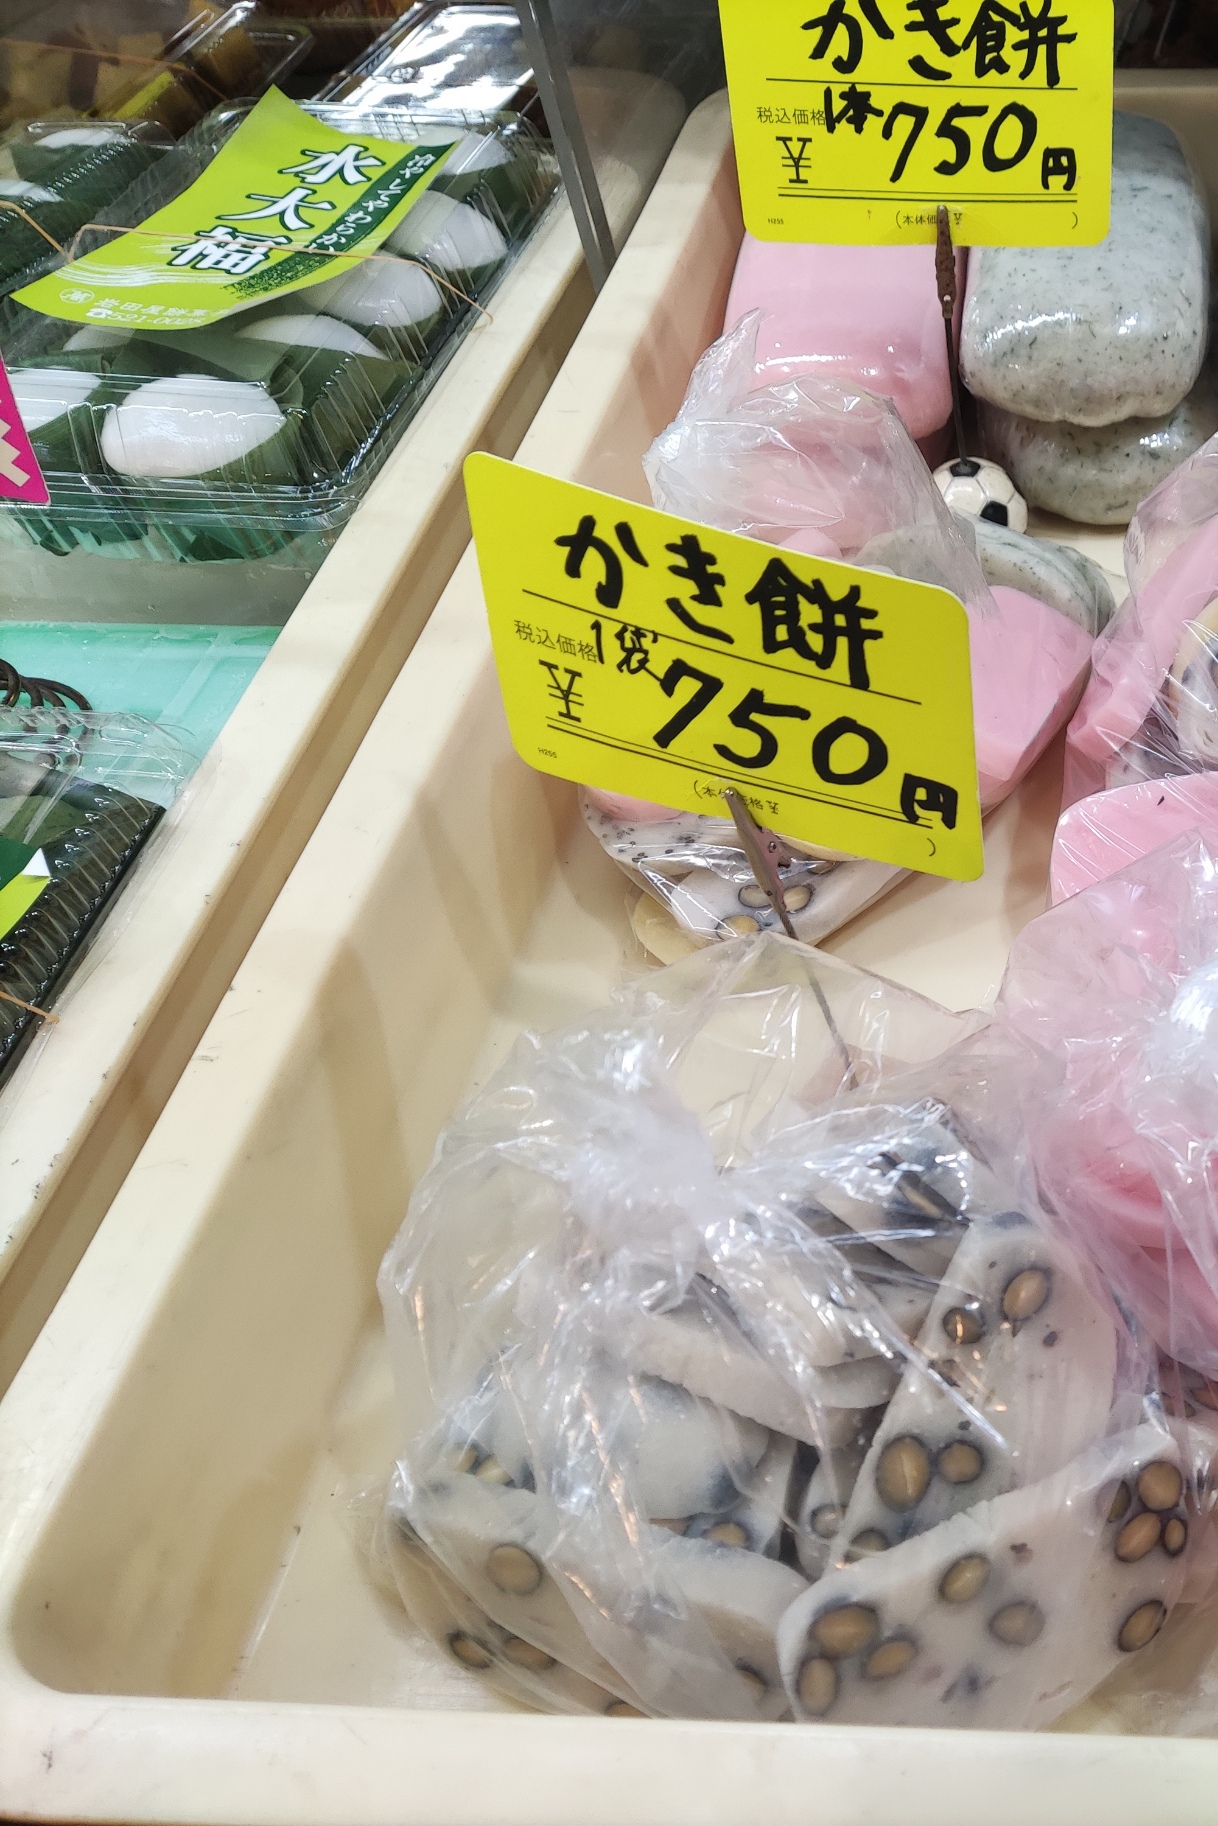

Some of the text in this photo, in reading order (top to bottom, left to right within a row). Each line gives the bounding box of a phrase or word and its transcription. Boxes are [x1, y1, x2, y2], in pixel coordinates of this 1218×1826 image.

[800, 0, 1078, 89] かき餅
[756, 106, 826, 126] 税込価格
[167, 143, 385, 275] 水大福
[514, 619, 598, 664] 税込価格
[554, 515, 883, 691] かき餅
